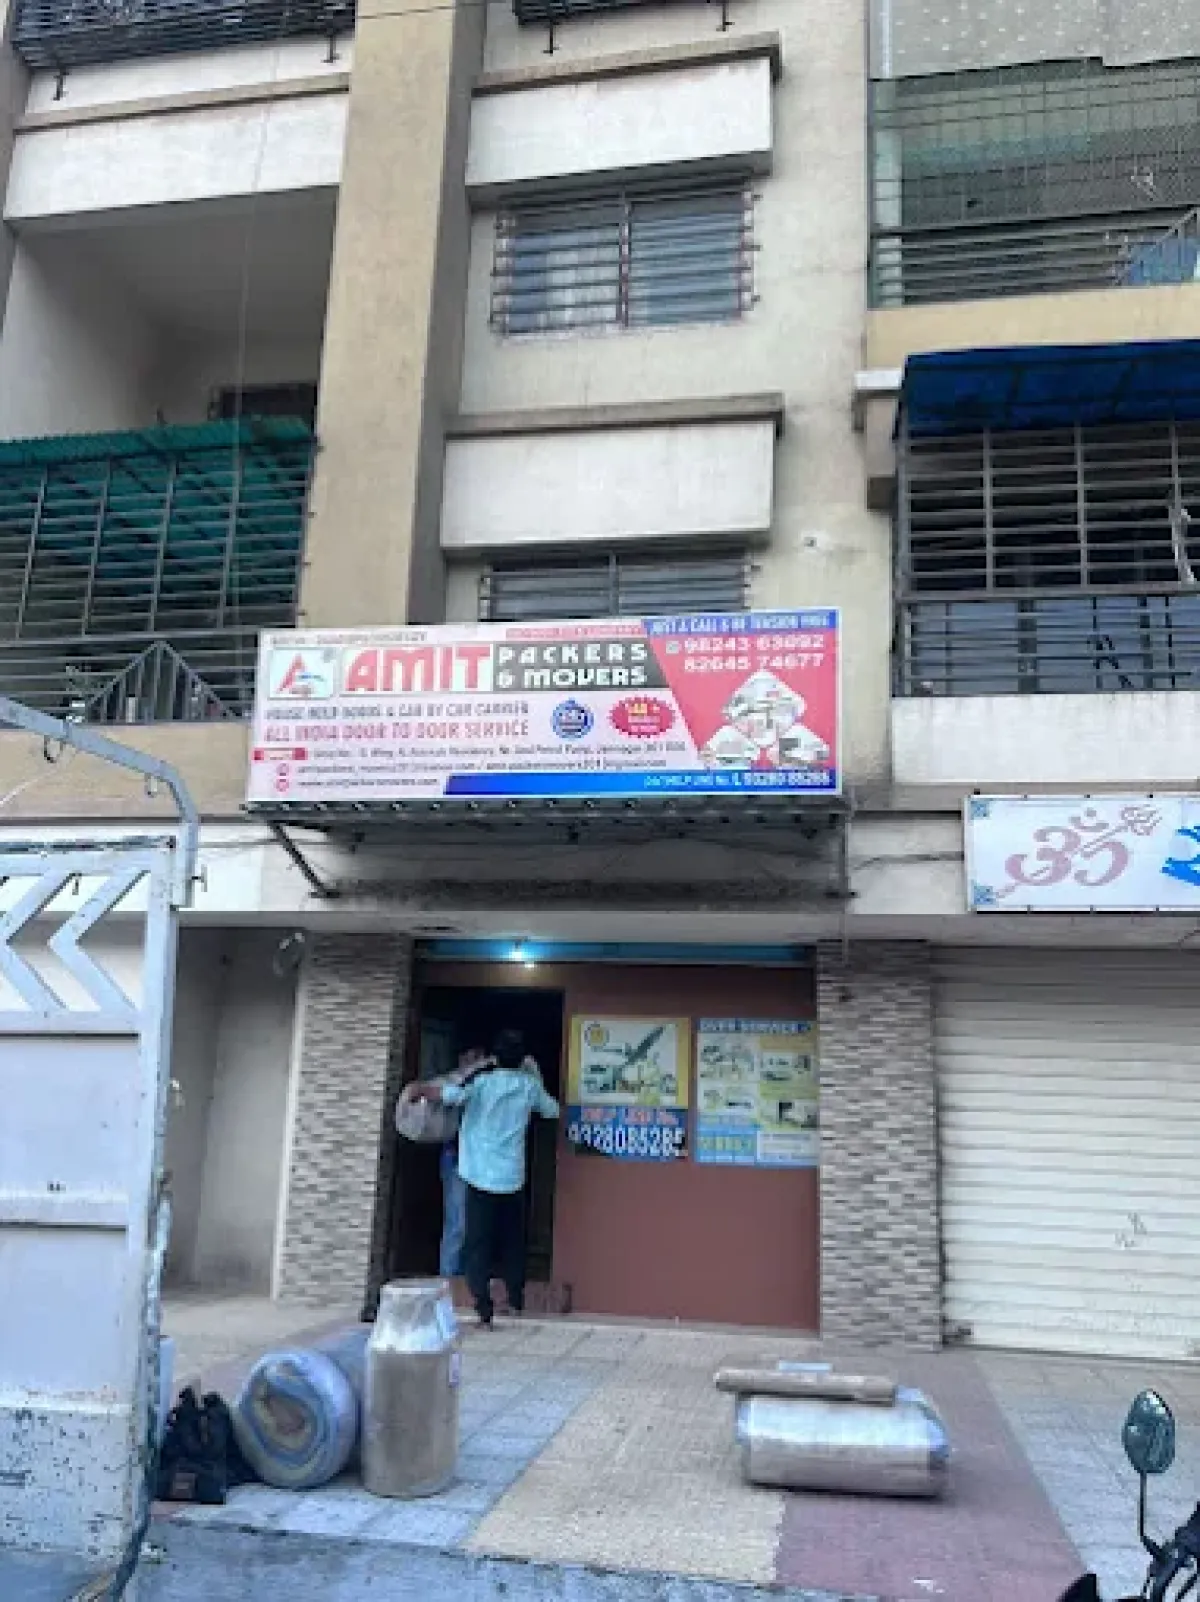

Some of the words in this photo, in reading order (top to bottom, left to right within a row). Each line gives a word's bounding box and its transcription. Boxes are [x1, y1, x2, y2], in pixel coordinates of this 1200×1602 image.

[498, 643, 648, 664] PACKERS
[345, 646, 491, 692] AMIT
[523, 666, 648, 688] MOVERS
[464, 719, 530, 738] SERVICE
